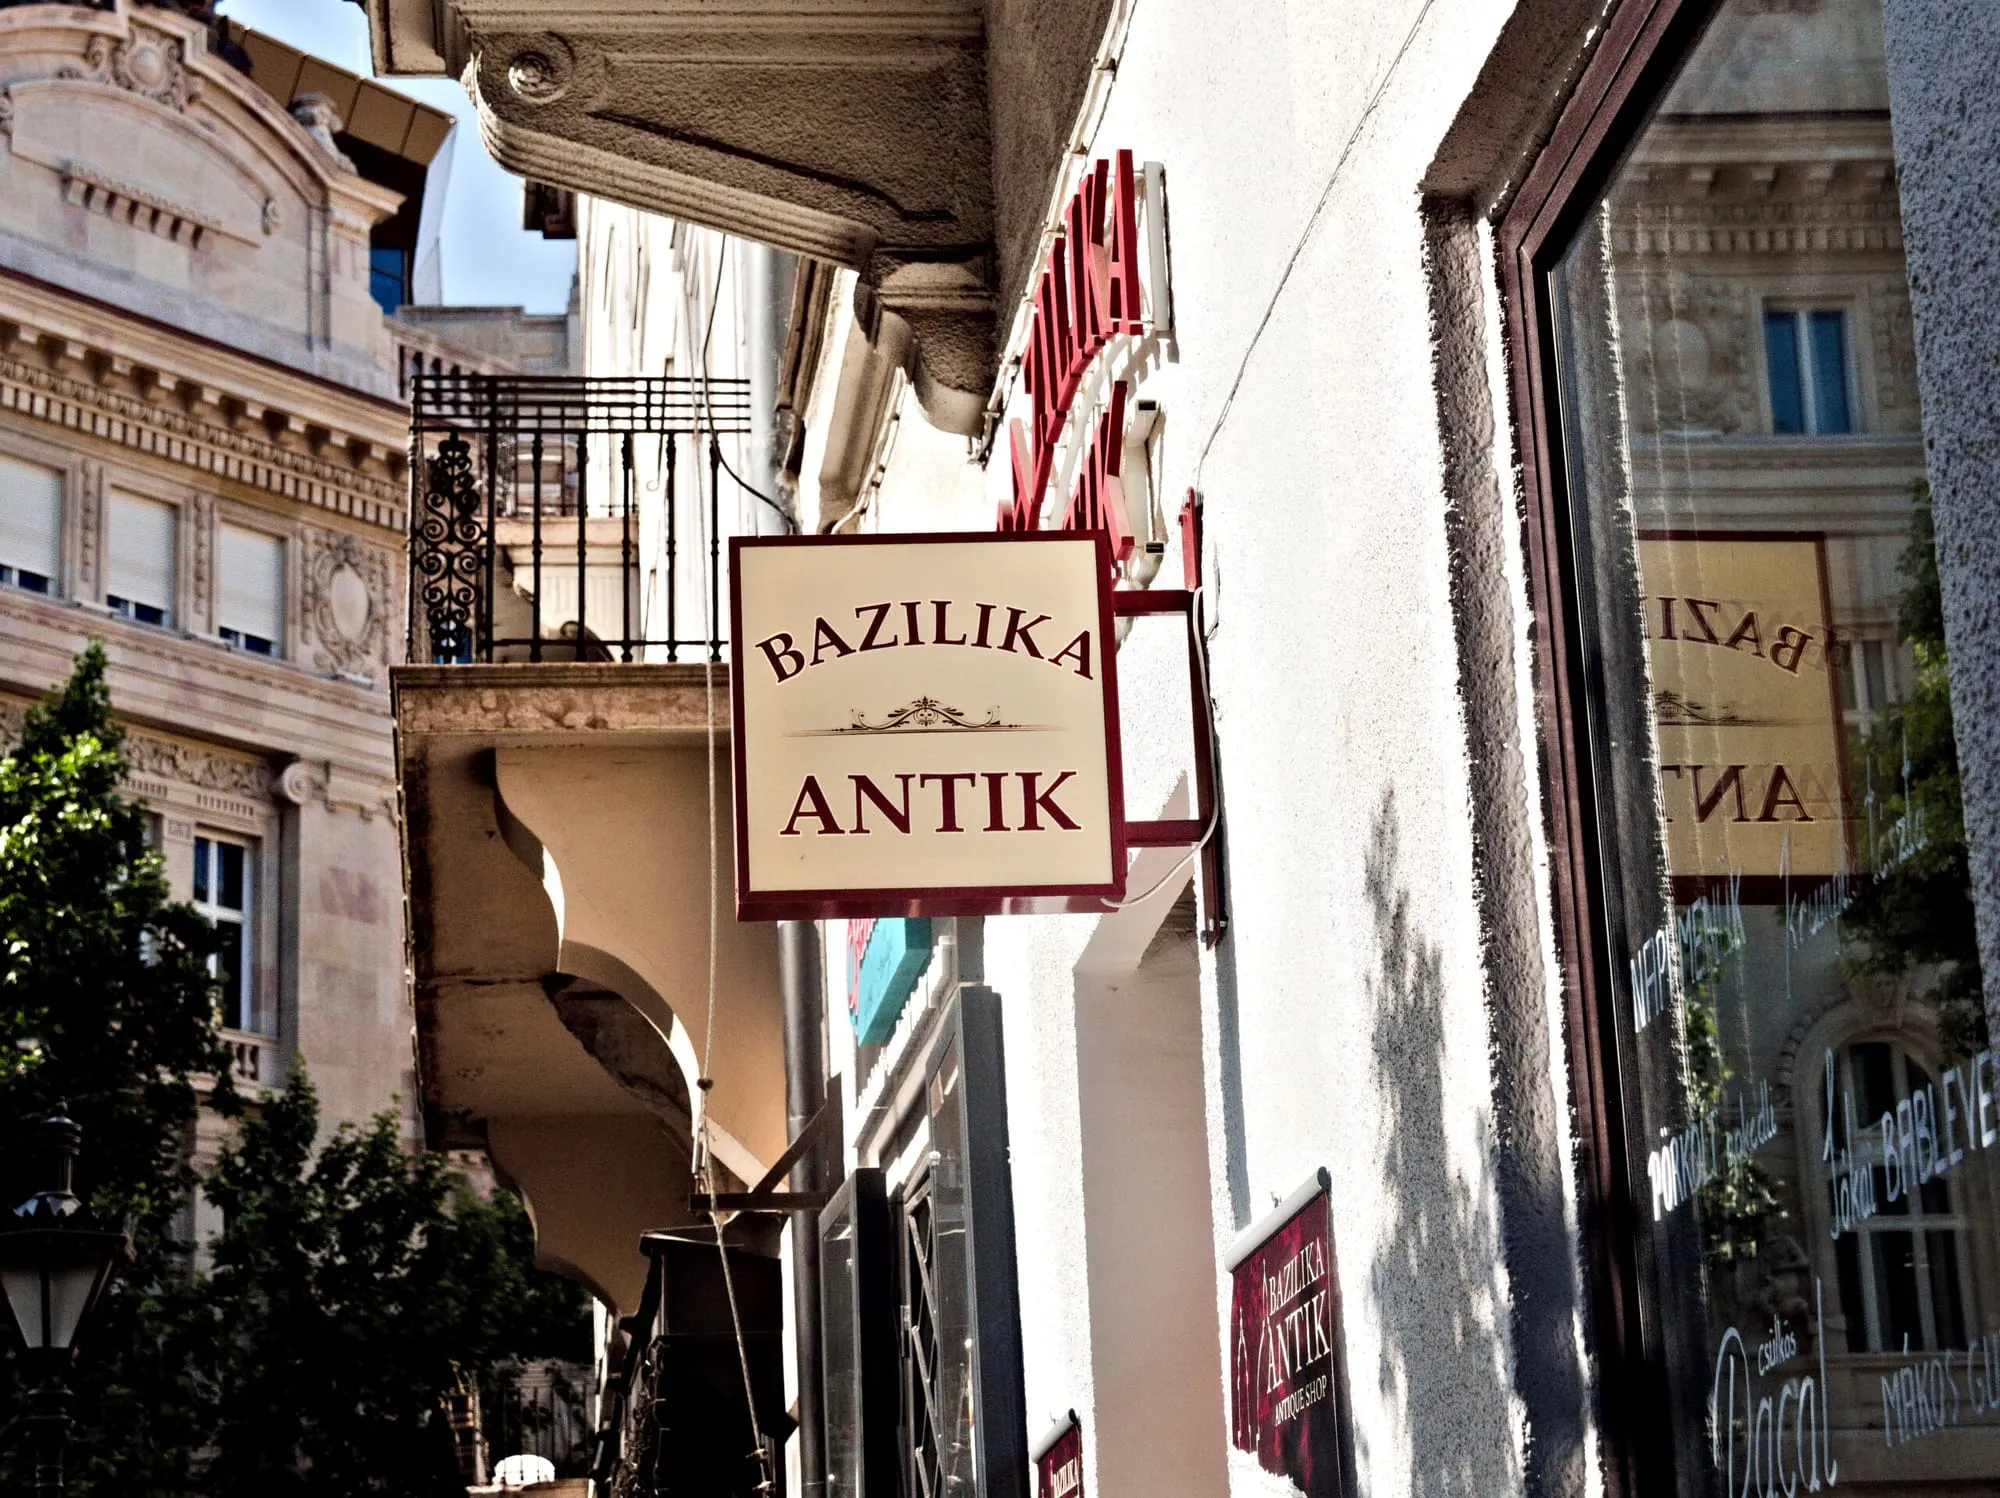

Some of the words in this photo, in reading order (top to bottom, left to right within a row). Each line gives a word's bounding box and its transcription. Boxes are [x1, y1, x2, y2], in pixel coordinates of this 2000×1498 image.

[996, 149, 1144, 531] AZILIKA
[756, 599, 1094, 684] BAZILIKA
[778, 770, 1083, 837] ANTIK
[1269, 1236, 1325, 1317] BAZILIKA
[1266, 1290, 1331, 1394] ANTIK
[1274, 1389, 1305, 1426] ANTIQUE
[1304, 1374, 1328, 1408] SHOP
[1880, 1331, 1961, 1449] MÁKOS
